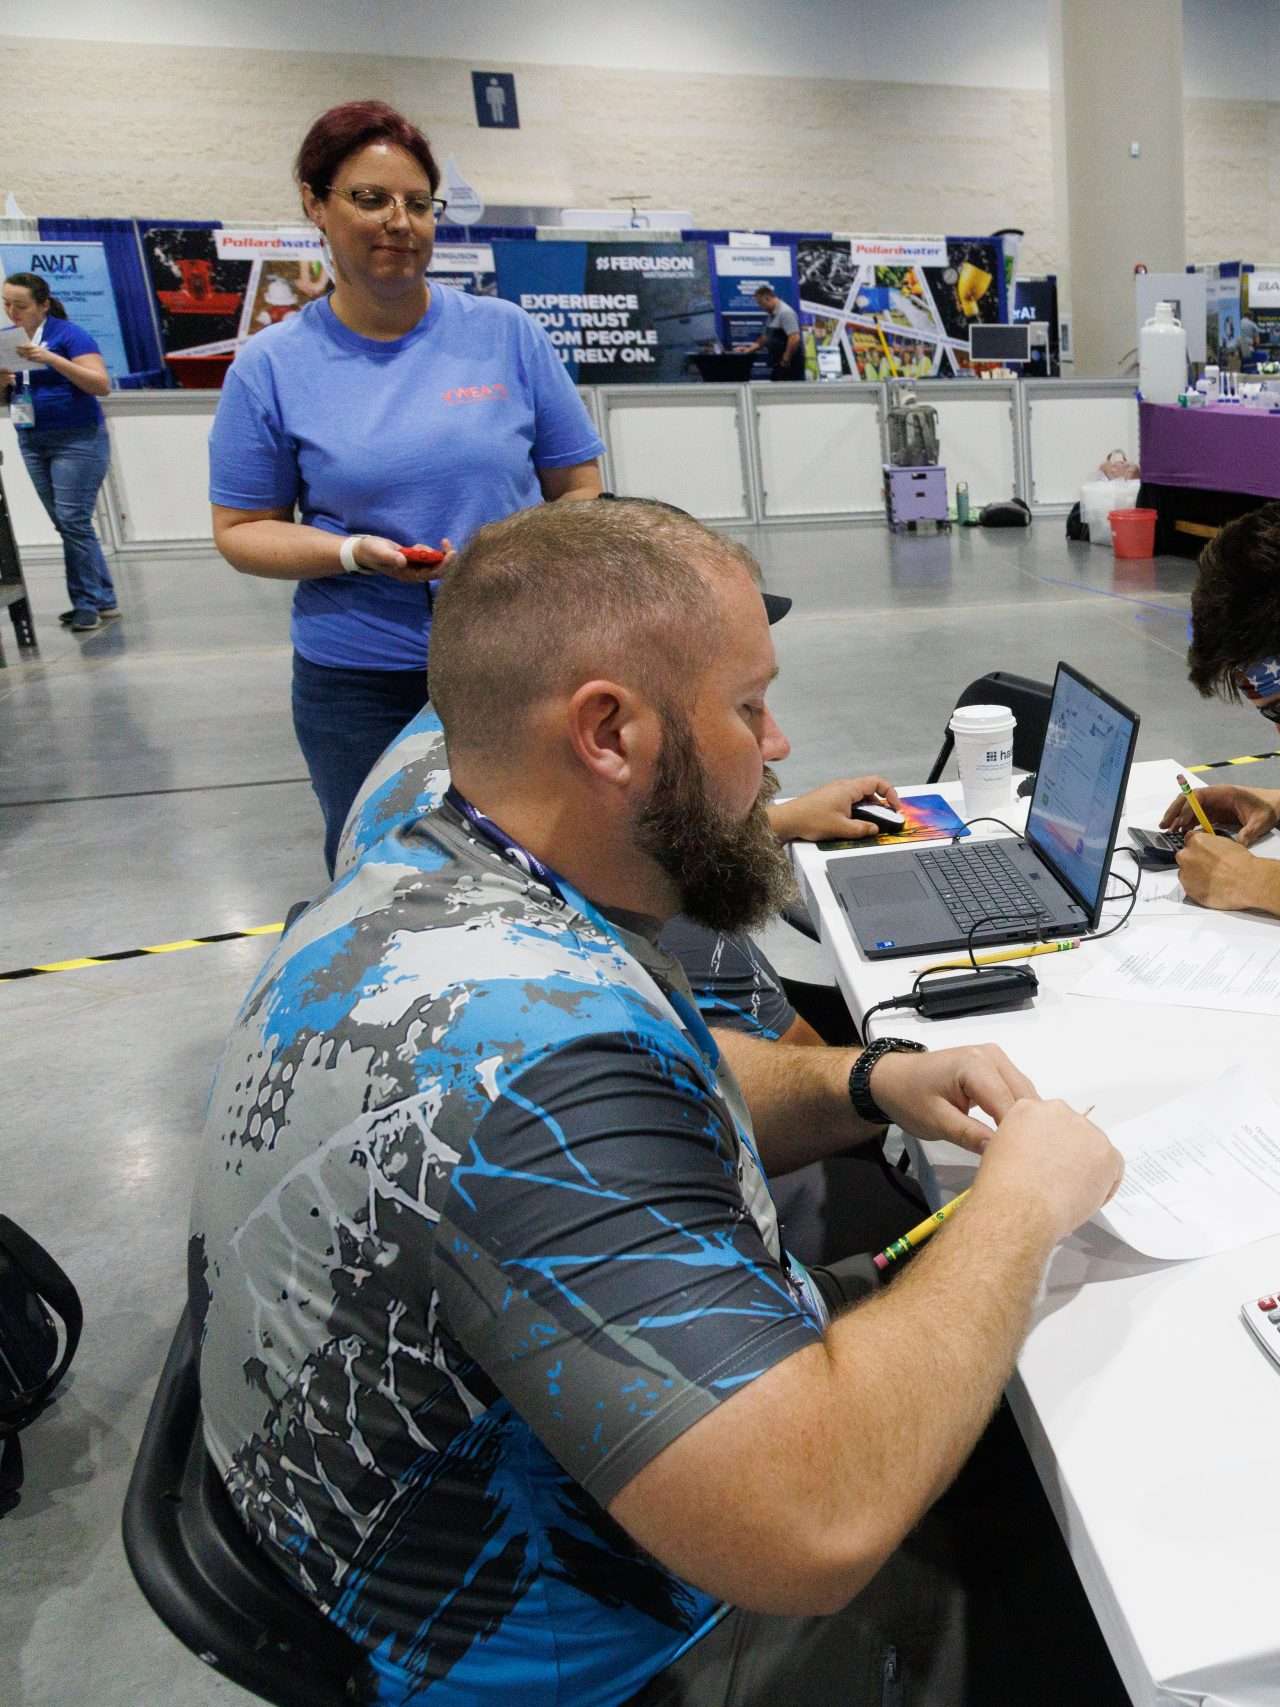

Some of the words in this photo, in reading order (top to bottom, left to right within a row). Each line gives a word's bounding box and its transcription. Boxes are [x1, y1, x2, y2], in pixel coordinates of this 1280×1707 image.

[222, 237, 323, 249] Pollardwate
[856, 244, 940, 256] Pollardwater
[31, 253, 79, 273] AWT
[611, 256, 694, 271] FERGUSON
[520, 294, 639, 310] EXPERIENCE
[568, 313, 630, 327] TRUST
[586, 331, 658, 345] PEOPLE
[573, 349, 617, 363] RELY
[621, 349, 656, 363] ON.
